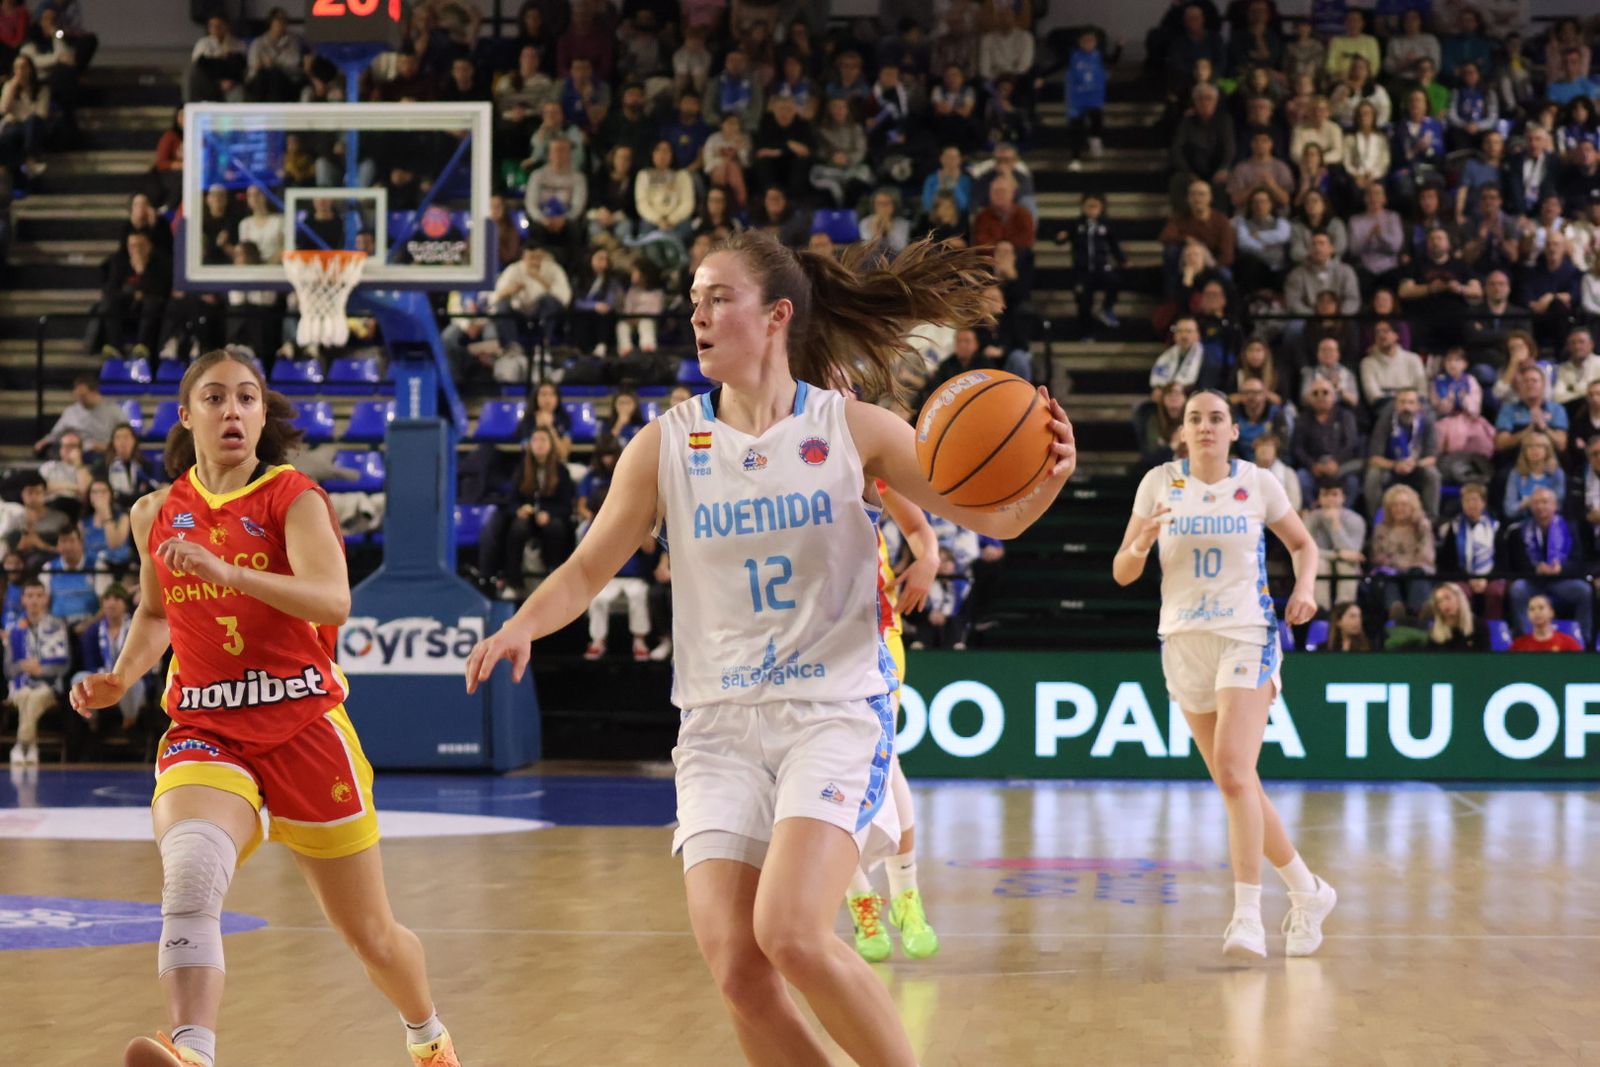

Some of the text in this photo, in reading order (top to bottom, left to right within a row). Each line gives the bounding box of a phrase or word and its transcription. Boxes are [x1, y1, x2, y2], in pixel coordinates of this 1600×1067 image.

[694, 489, 833, 538] AVENIDA
[1168, 515, 1248, 535] AVENIDA
[744, 555, 796, 612] 12
[1193, 548, 1221, 578] 10
[164, 582, 247, 605] ΑΘΗΝΑ
[215, 616, 245, 656] 3
[179, 666, 328, 709] novibet
[1325, 683, 1453, 759] TU
